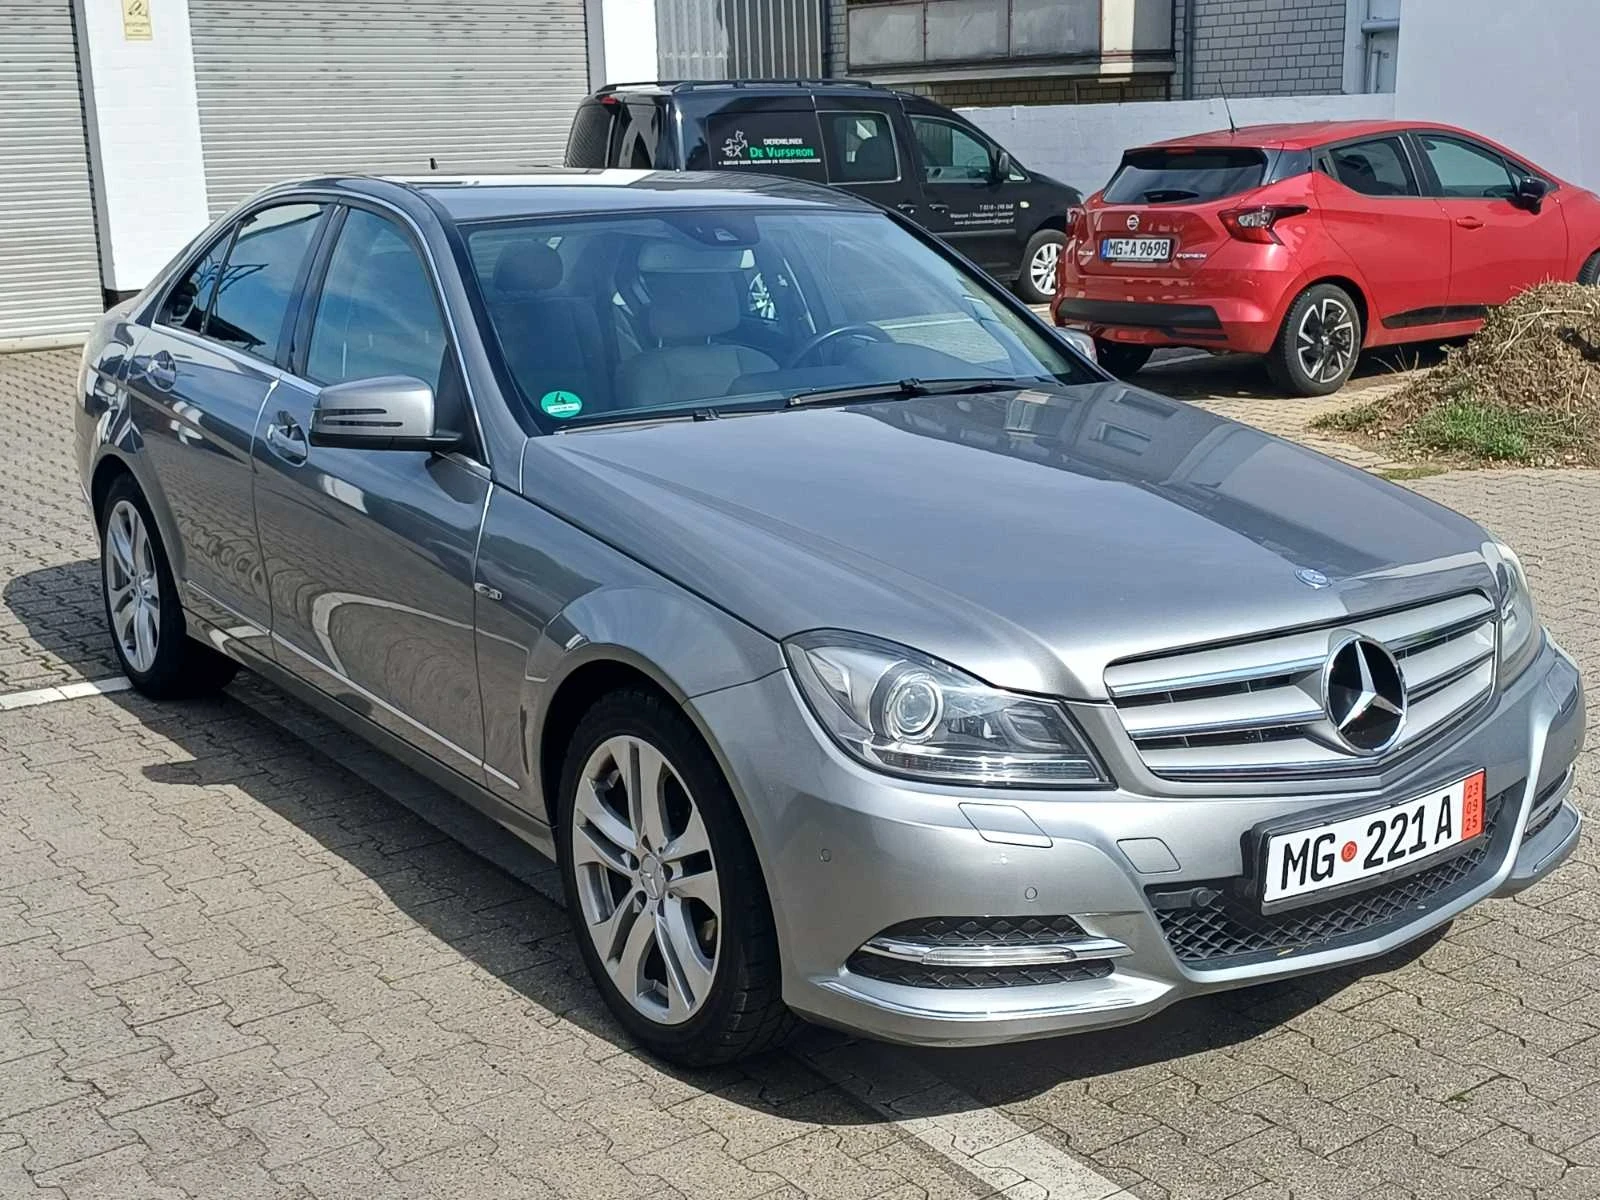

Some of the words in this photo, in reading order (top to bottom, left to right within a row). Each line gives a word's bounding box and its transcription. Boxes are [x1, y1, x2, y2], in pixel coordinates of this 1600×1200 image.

[1108, 241, 1123, 256] MG
[1129, 241, 1137, 256] A
[1140, 241, 1168, 256] 9698
[551, 391, 566, 404] 4
[1467, 782, 1478, 799] 23
[1466, 799, 1478, 815] 09
[1465, 814, 1478, 831] 25
[1281, 833, 1335, 890] MG
[1363, 806, 1427, 869] 221
[1434, 795, 1452, 845] A
